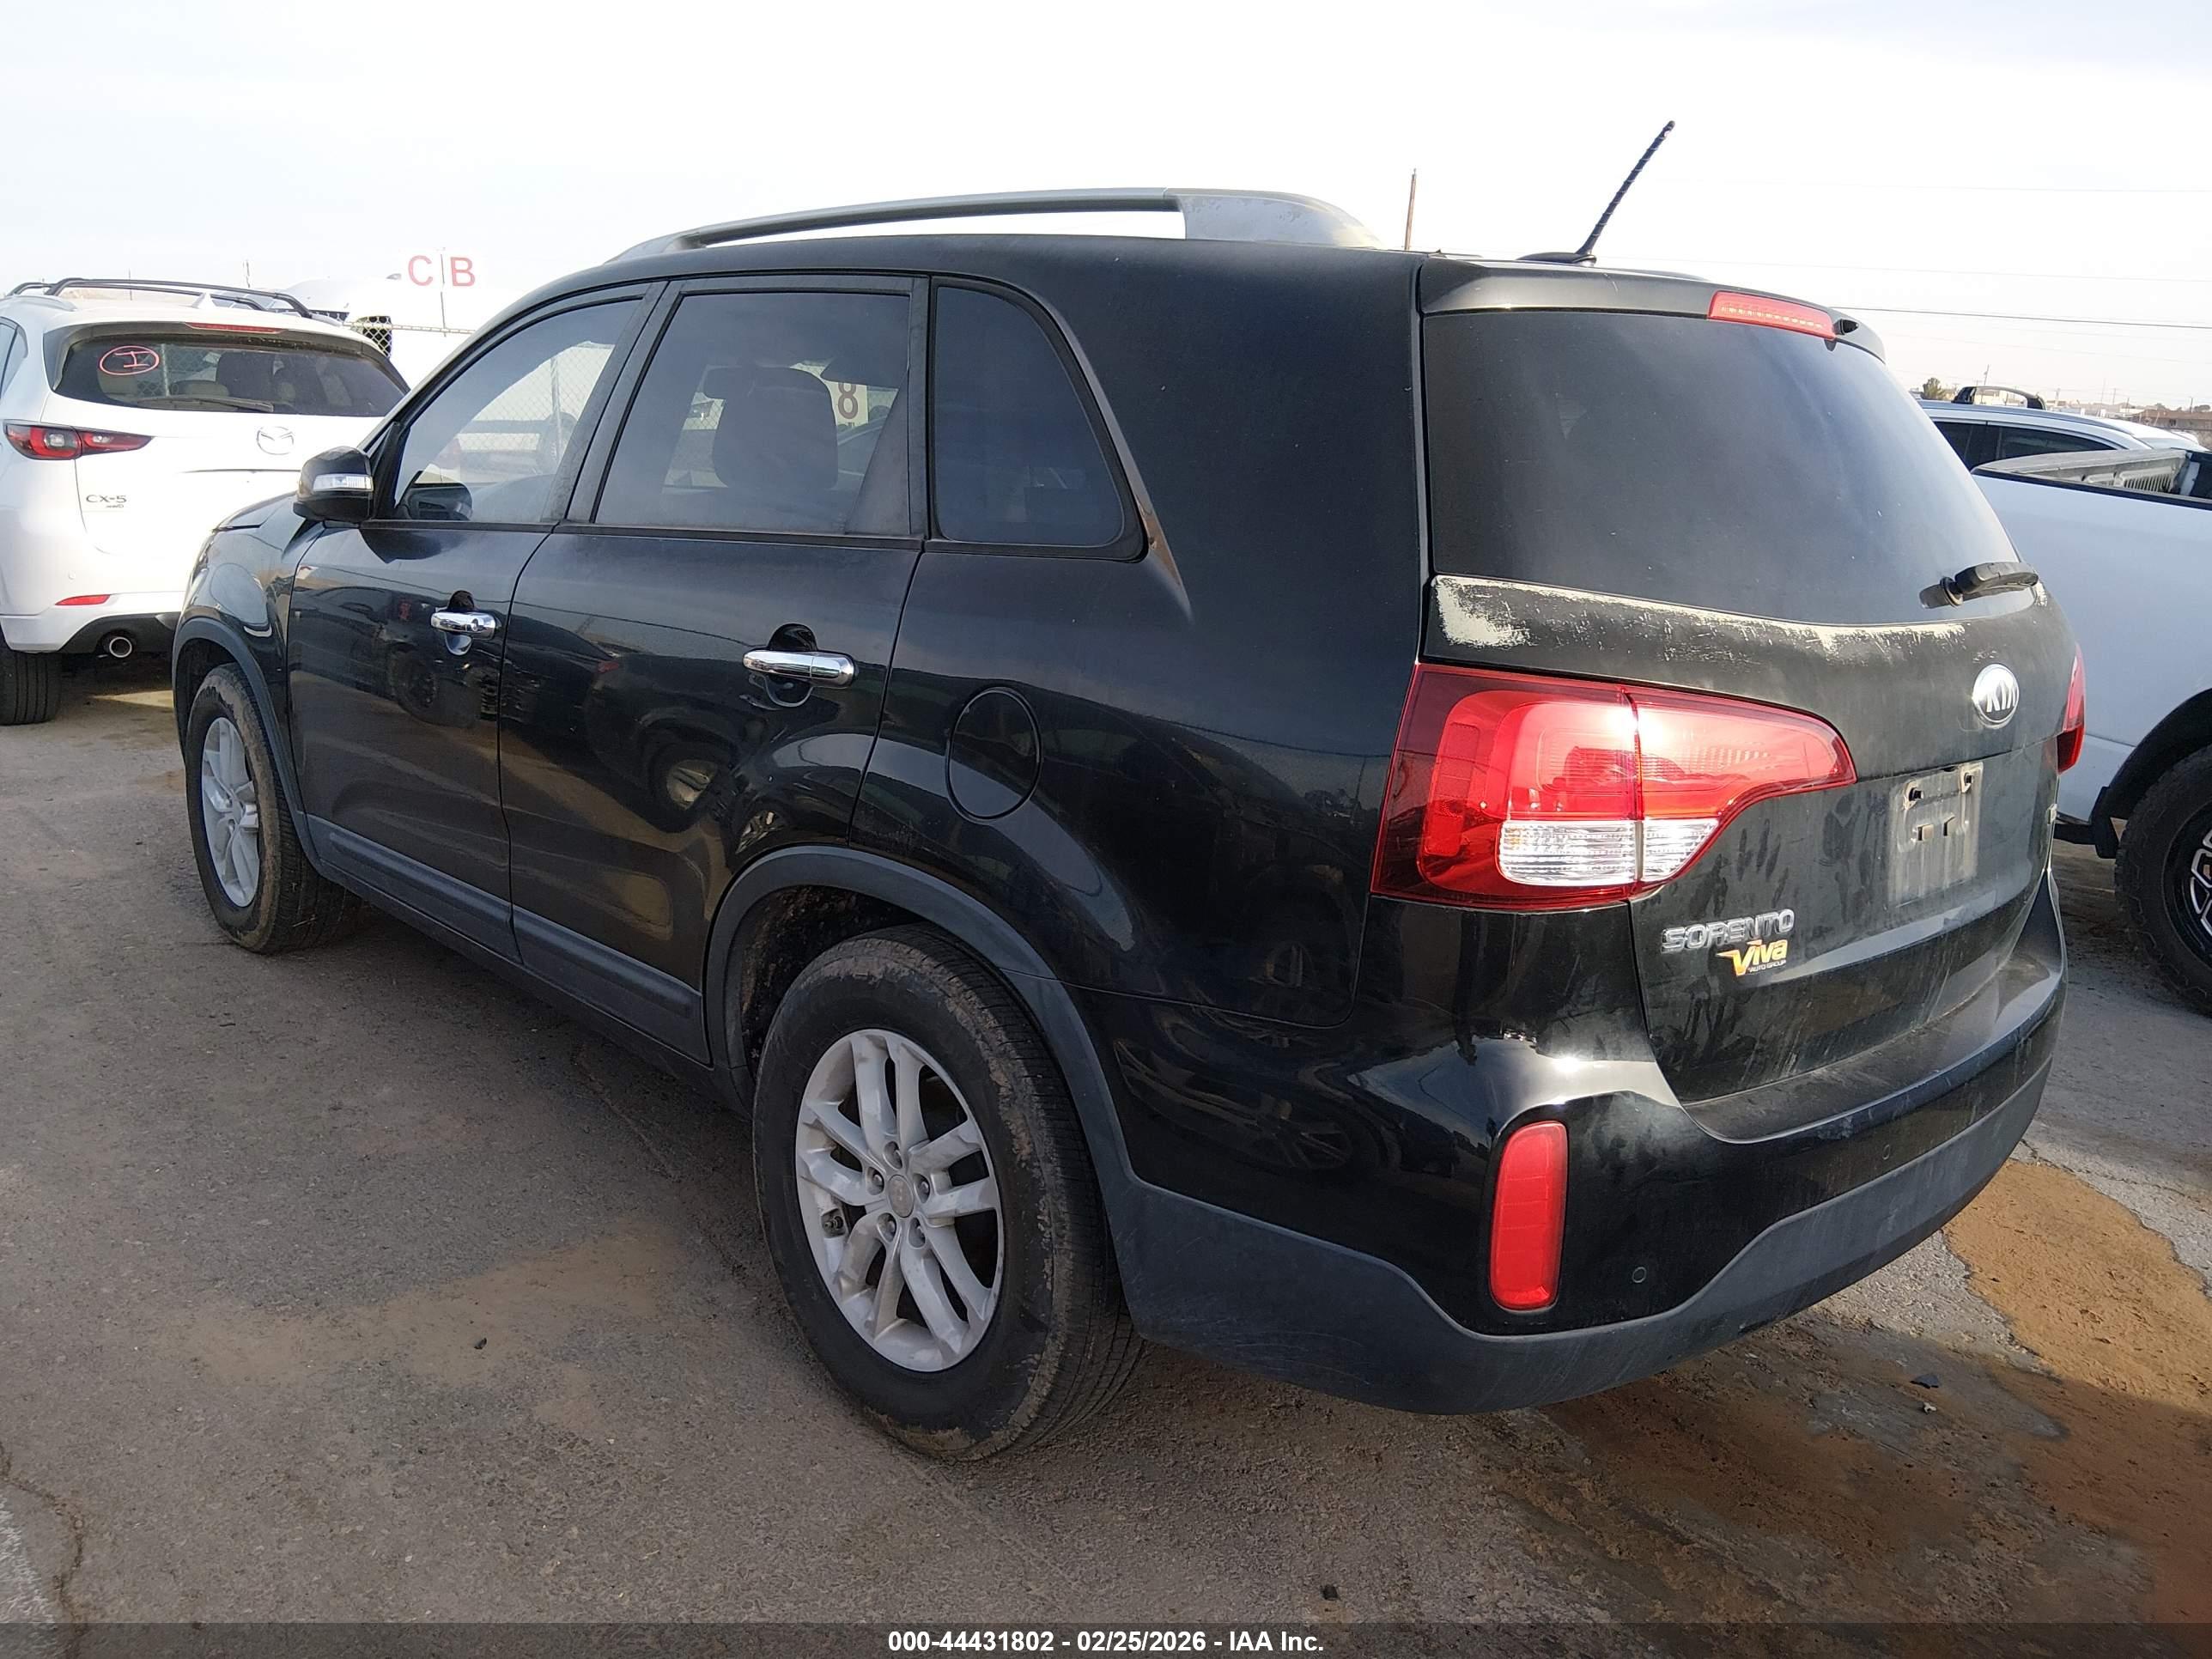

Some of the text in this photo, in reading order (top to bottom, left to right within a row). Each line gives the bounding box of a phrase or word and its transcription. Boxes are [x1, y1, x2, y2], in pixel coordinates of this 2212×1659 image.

[408, 255, 476, 287] C B
[837, 382, 859, 420] 8
[86, 494, 127, 503] CX-5
[1661, 908, 1795, 954] SORENTO
[1717, 939, 1788, 976] Viva
